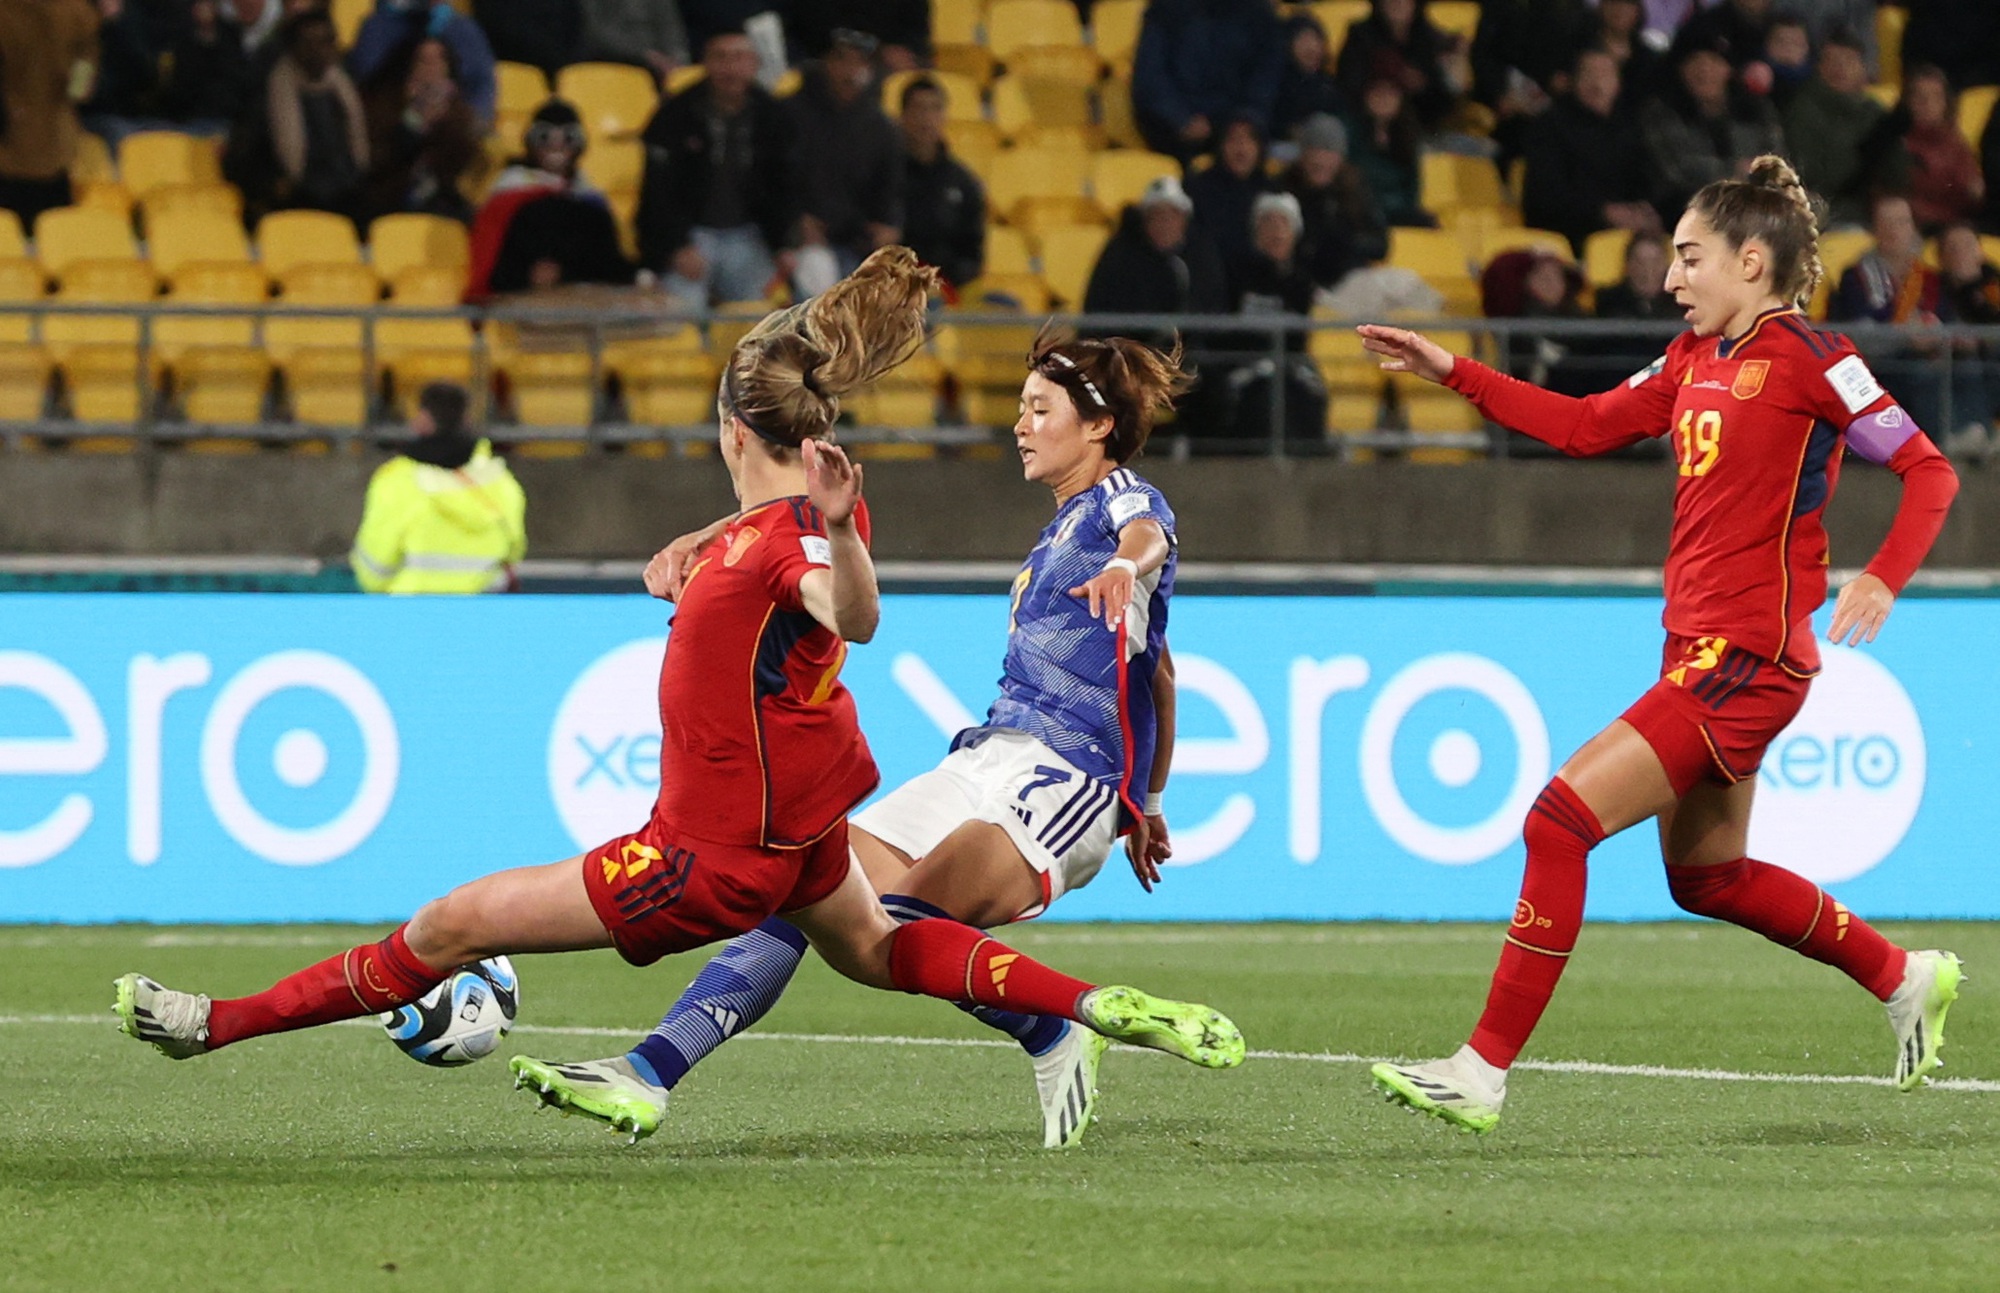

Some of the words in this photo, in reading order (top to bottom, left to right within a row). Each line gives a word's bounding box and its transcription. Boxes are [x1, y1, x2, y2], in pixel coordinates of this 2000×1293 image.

[1679, 409, 1722, 476] 19
[890, 651, 1550, 866] ero
[1018, 764, 1073, 802] 7
[1758, 734, 1900, 788] ero
